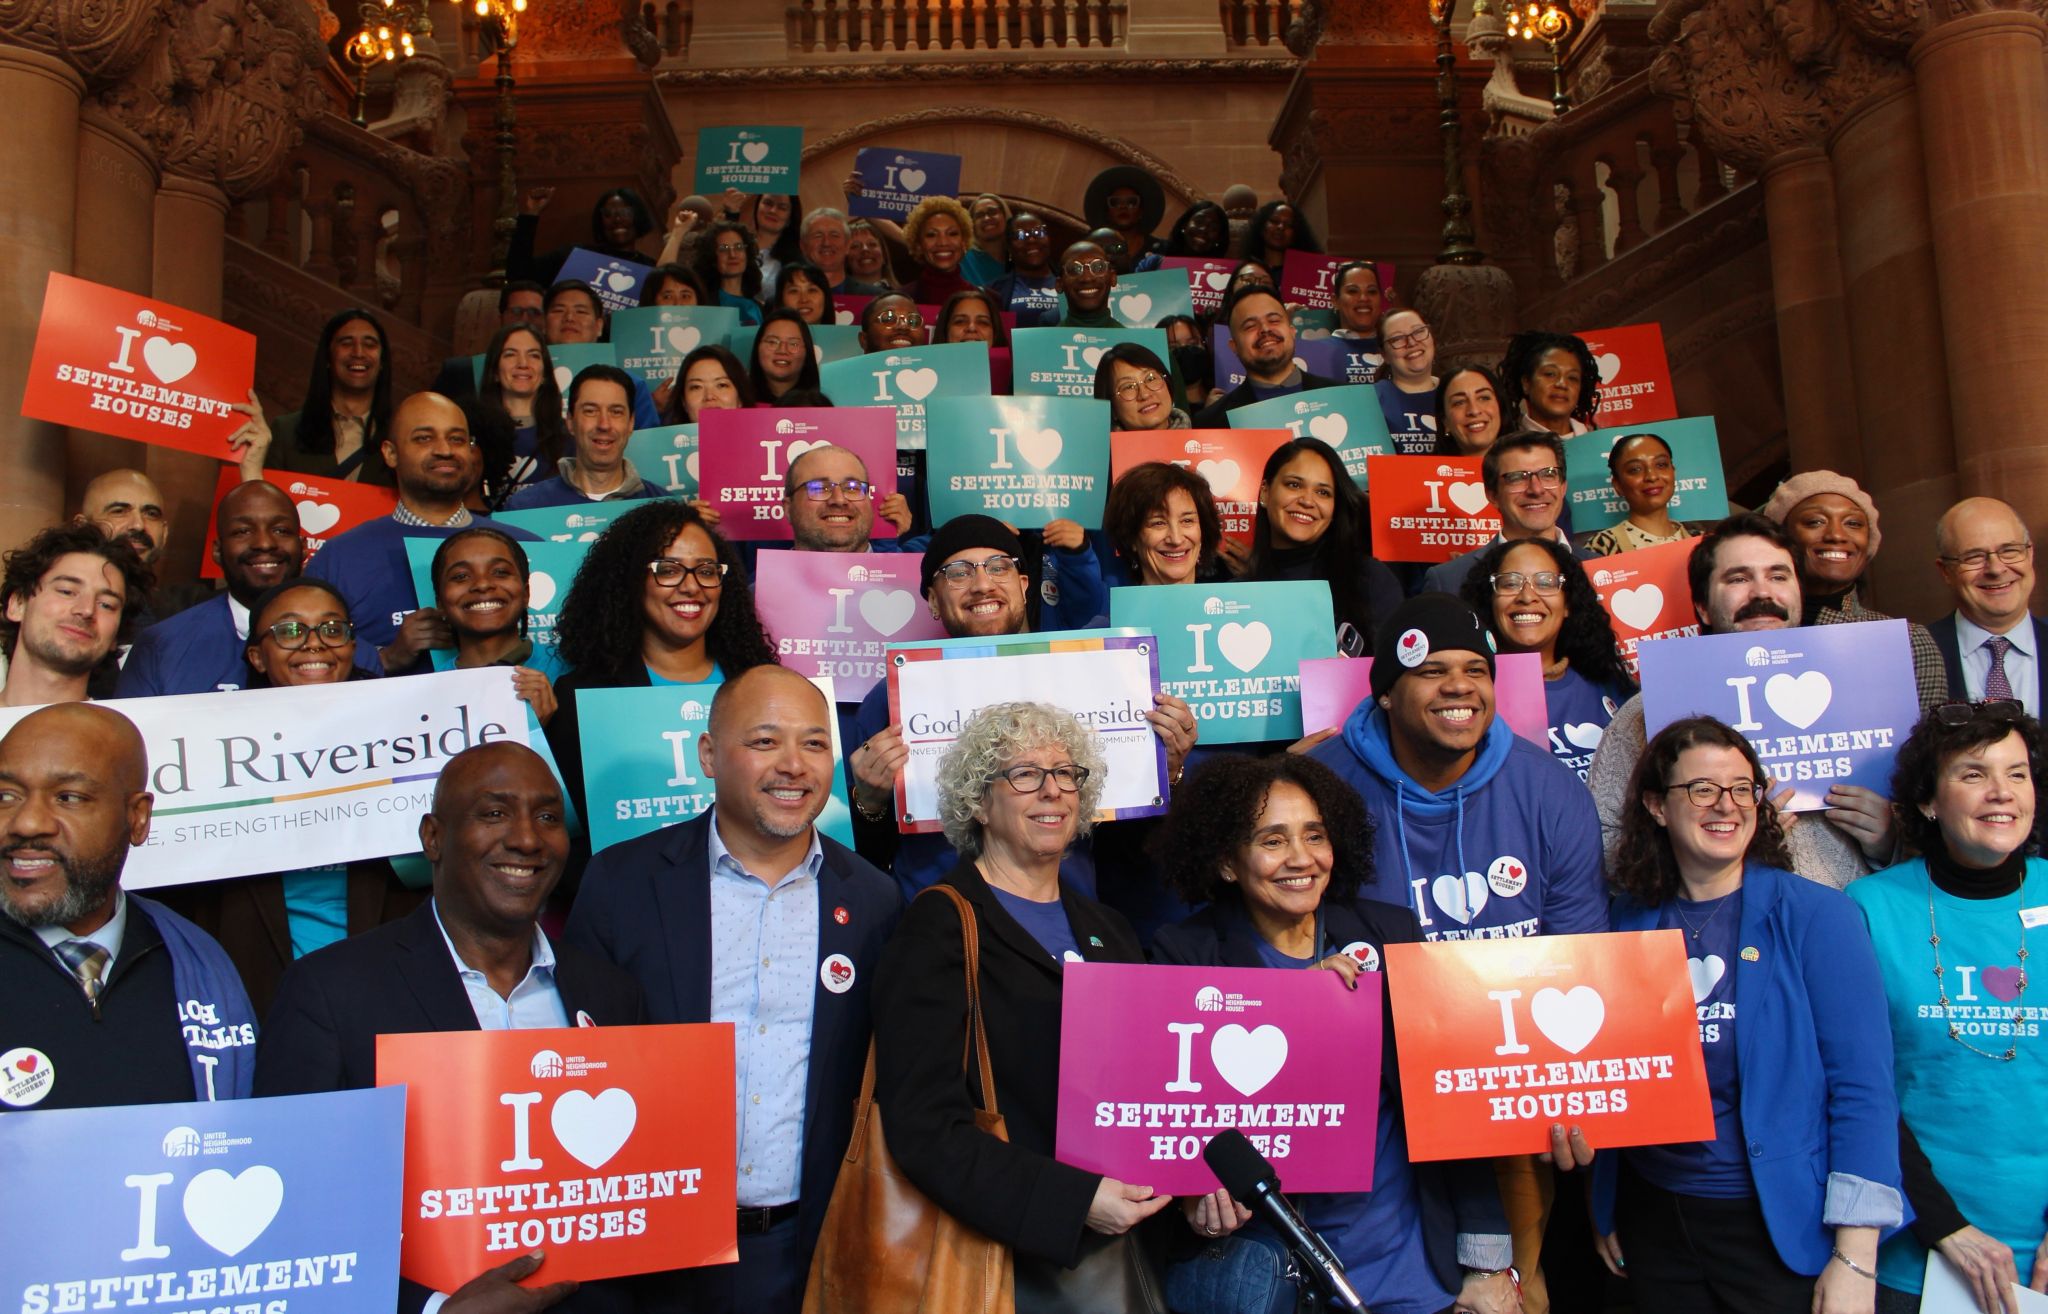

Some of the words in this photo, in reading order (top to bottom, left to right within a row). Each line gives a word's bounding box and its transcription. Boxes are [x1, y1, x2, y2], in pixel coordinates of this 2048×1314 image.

[727, 142, 740, 163] I
[705, 165, 788, 175] SETTLEMENT
[721, 175, 770, 184] HOUSES
[884, 166, 898, 189] I
[862, 189, 924, 203] SETTLEM
[1308, 299, 1334, 309] HOU
[108, 326, 141, 373] I
[650, 327, 666, 353] I
[624, 357, 684, 368] SETTLE
[1061, 345, 1079, 370] I
[646, 370, 678, 380] HOU
[872, 371, 893, 401] I
[1348, 375, 1375, 383] HOU
[56, 364, 232, 418] SETTLEMENT
[1058, 386, 1095, 396] HOU
[90, 393, 193, 429] HOUSES
[1403, 413, 1421, 431] I
[760, 440, 784, 481] I
[989, 428, 1013, 469] I
[1403, 443, 1434, 453] HOU
[662, 454, 685, 491] I
[950, 474, 1094, 491] SETTLEMENT
[983, 493, 1070, 509] HOUSES
[1424, 481, 1446, 513] I
[1390, 516, 1502, 531] SETTLEME
[827, 588, 854, 633] I
[778, 638, 886, 657] SETTLE
[1186, 623, 1212, 673] I
[816, 660, 886, 678] HOUS
[1160, 675, 1300, 698] ETTLEMEN
[1726, 676, 1763, 731] I
[662, 730, 697, 787] I
[616, 793, 715, 820] SETTL
[174, 800, 369, 844] STRENGTHENING
[1500, 863, 1505, 873] I
[1955, 966, 1978, 1001] I
[1488, 989, 1529, 1056] I
[566, 1062, 607, 1070] NEIGHBORHOOD
[1165, 1022, 1204, 1093] I
[566, 1069, 588, 1077] HOUSES
[1435, 1055, 1674, 1094] SETTLEMENT
[1095, 1102, 1345, 1128] SETTLEMENT
[1489, 1089, 1628, 1121] HOUSES
[203, 1131, 227, 1140] UNITED
[203, 1137, 252, 1148] NEIGHBORHOOD
[500, 1092, 543, 1172] I
[203, 1146, 228, 1155] HOUSES
[420, 1168, 701, 1219] SETTLEMENT
[120, 1172, 174, 1262] I
[486, 1208, 646, 1251] HOUSES
[21, 1252, 357, 1314] SETTLEMENT
